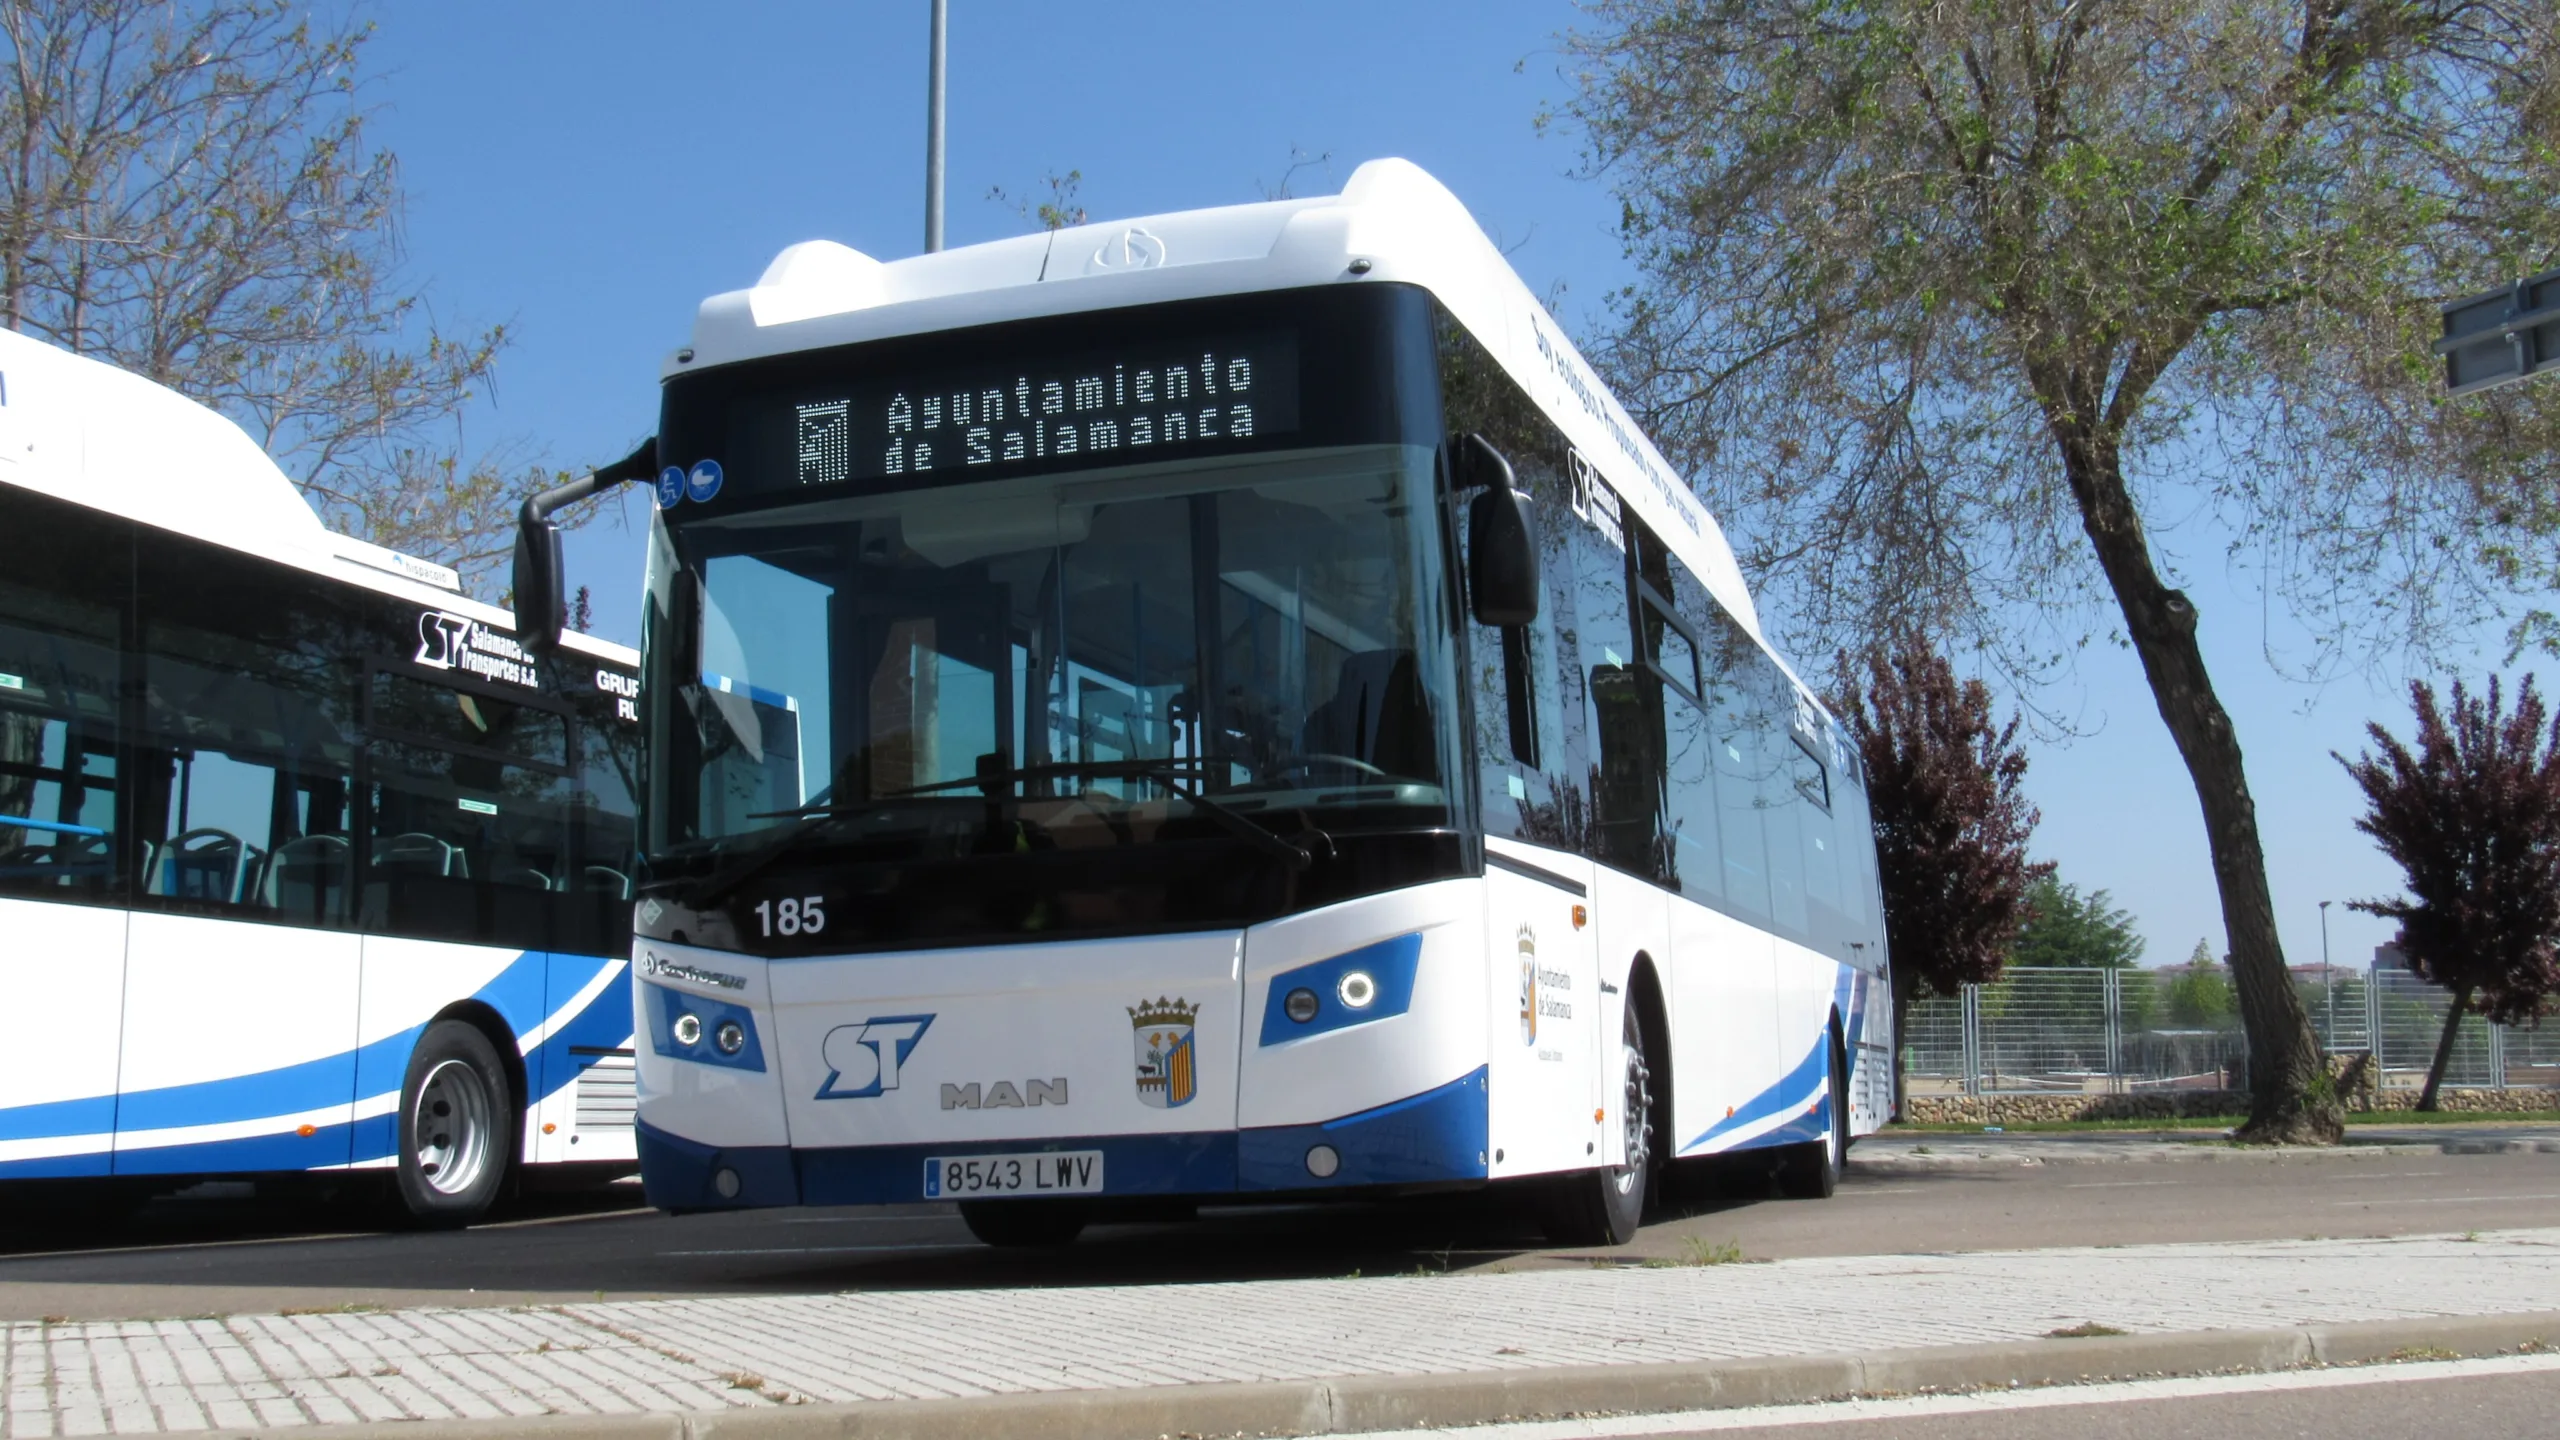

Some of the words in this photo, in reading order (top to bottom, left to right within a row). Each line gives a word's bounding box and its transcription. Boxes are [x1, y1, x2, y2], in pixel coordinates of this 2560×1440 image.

[887, 353, 1252, 434] Ayuntamiento
[885, 437, 933, 475] de
[966, 404, 1254, 465] Salamanca
[414, 611, 472, 670] ST
[470, 622, 522, 661] Salamanca
[461, 642, 520, 682] Transportes
[520, 665, 539, 689] s.a.
[595, 669, 640, 699] GRUP
[755, 896, 826, 937] 185
[814, 1013, 938, 1101] ST
[940, 1077, 1068, 1111] MAN
[946, 1160, 1022, 1192] 8543
[1035, 1156, 1093, 1189] LWV
